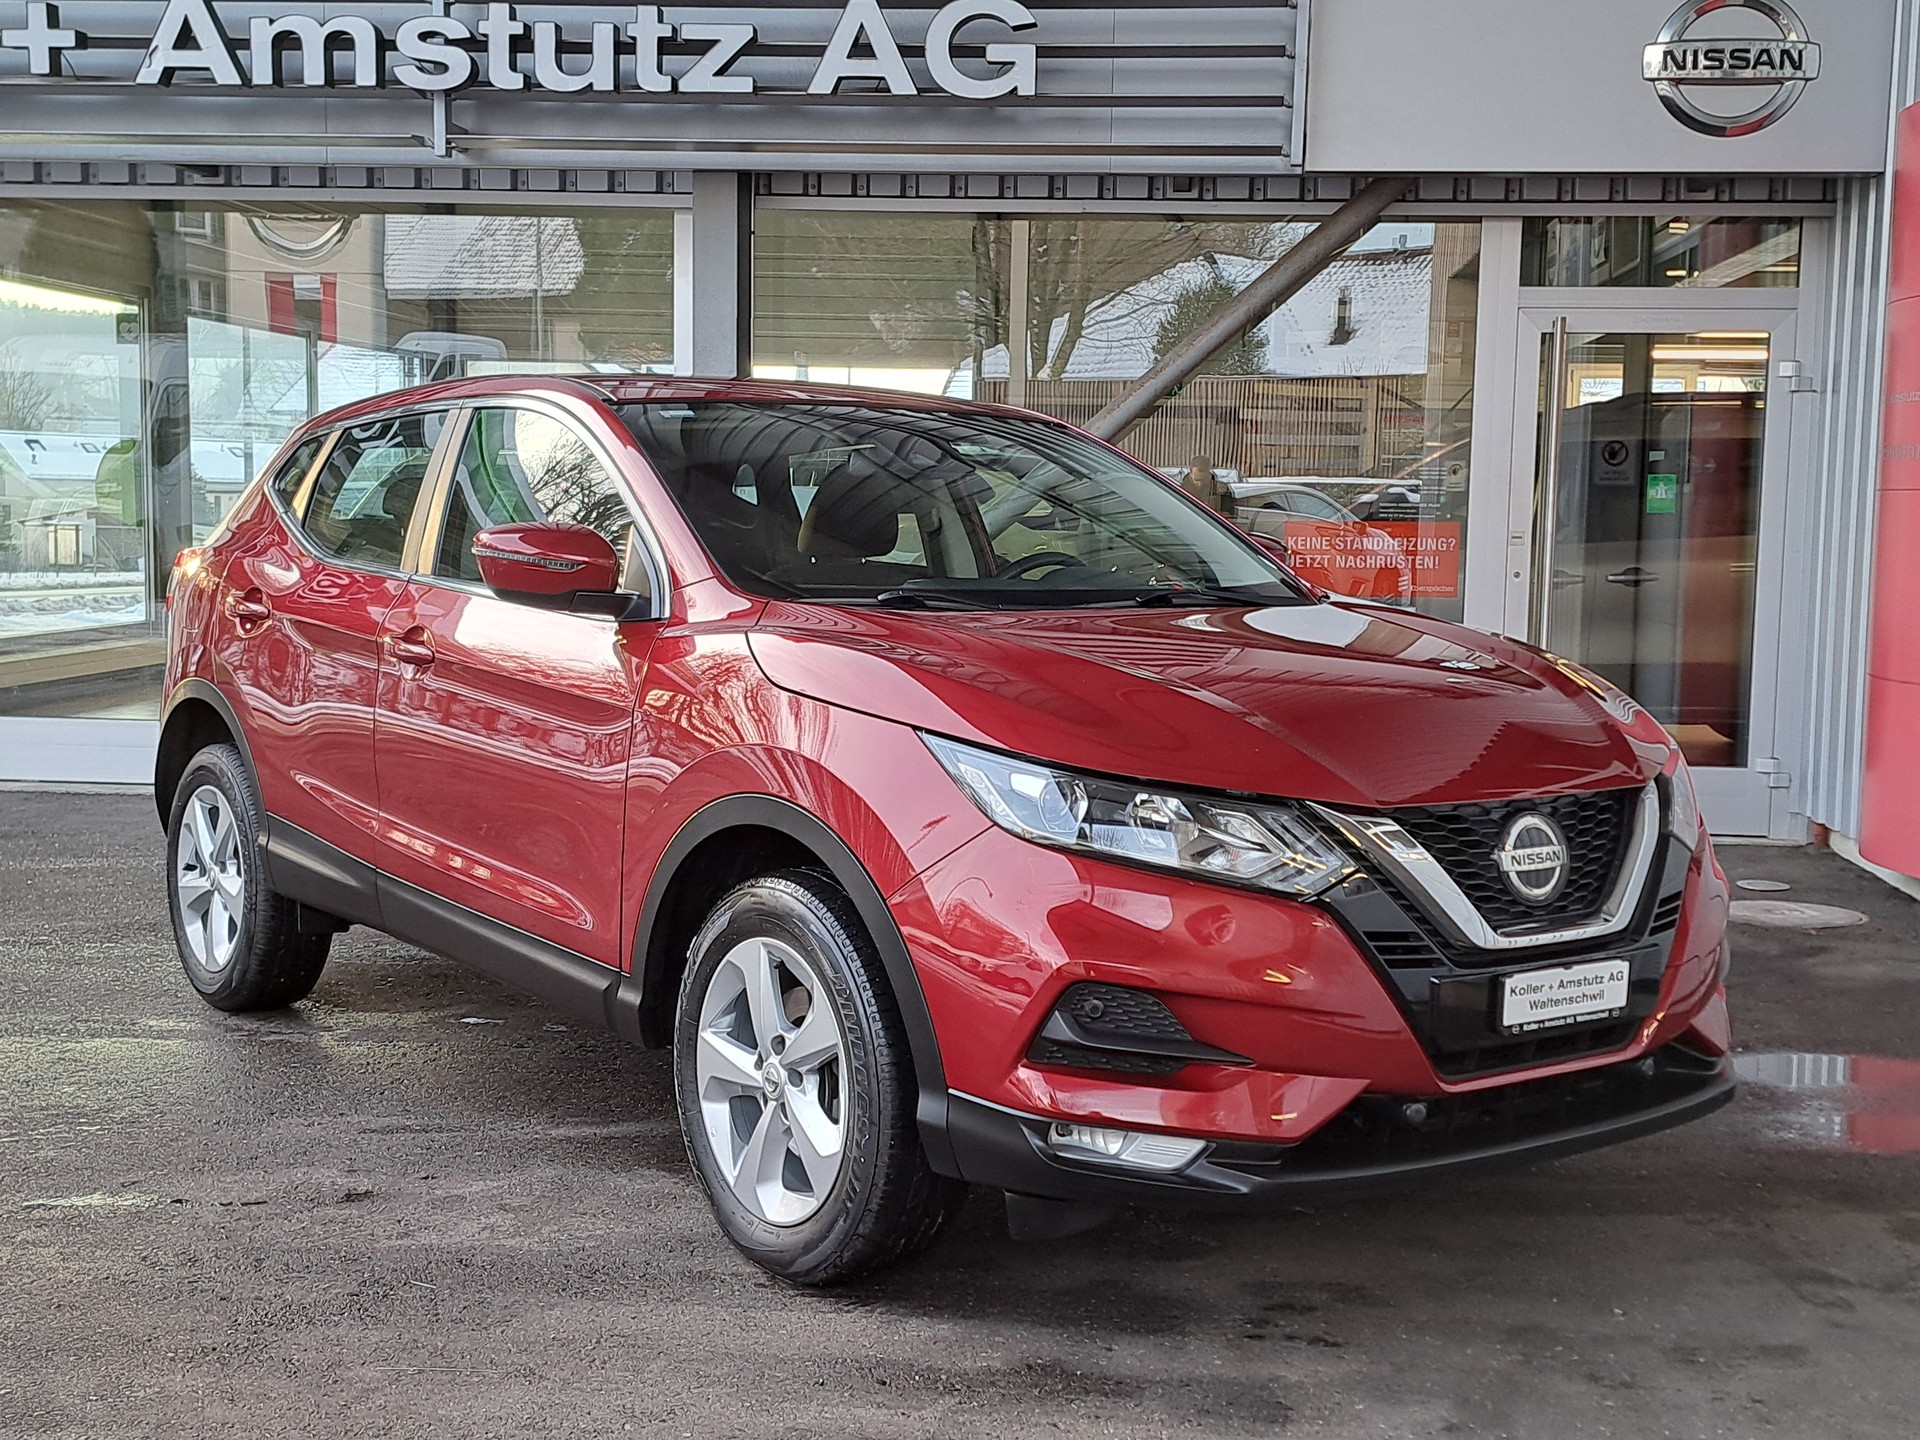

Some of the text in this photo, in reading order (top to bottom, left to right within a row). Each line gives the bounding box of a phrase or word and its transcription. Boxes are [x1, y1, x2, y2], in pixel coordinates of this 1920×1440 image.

[135, 0, 756, 93] Amstutz
[806, 0, 1040, 100] AG
[1662, 48, 1804, 71] NISSAN
[1288, 536, 1457, 551] KEINE STANDHEIZUNG?
[1290, 554, 1331, 568] JETZT
[1511, 850, 1561, 867] NISSAN
[1509, 982, 1546, 998] Koller
[1557, 974, 1605, 991] Amstutz
[1608, 970, 1625, 983] AG
[1528, 989, 1606, 1012] Waltenschwil
